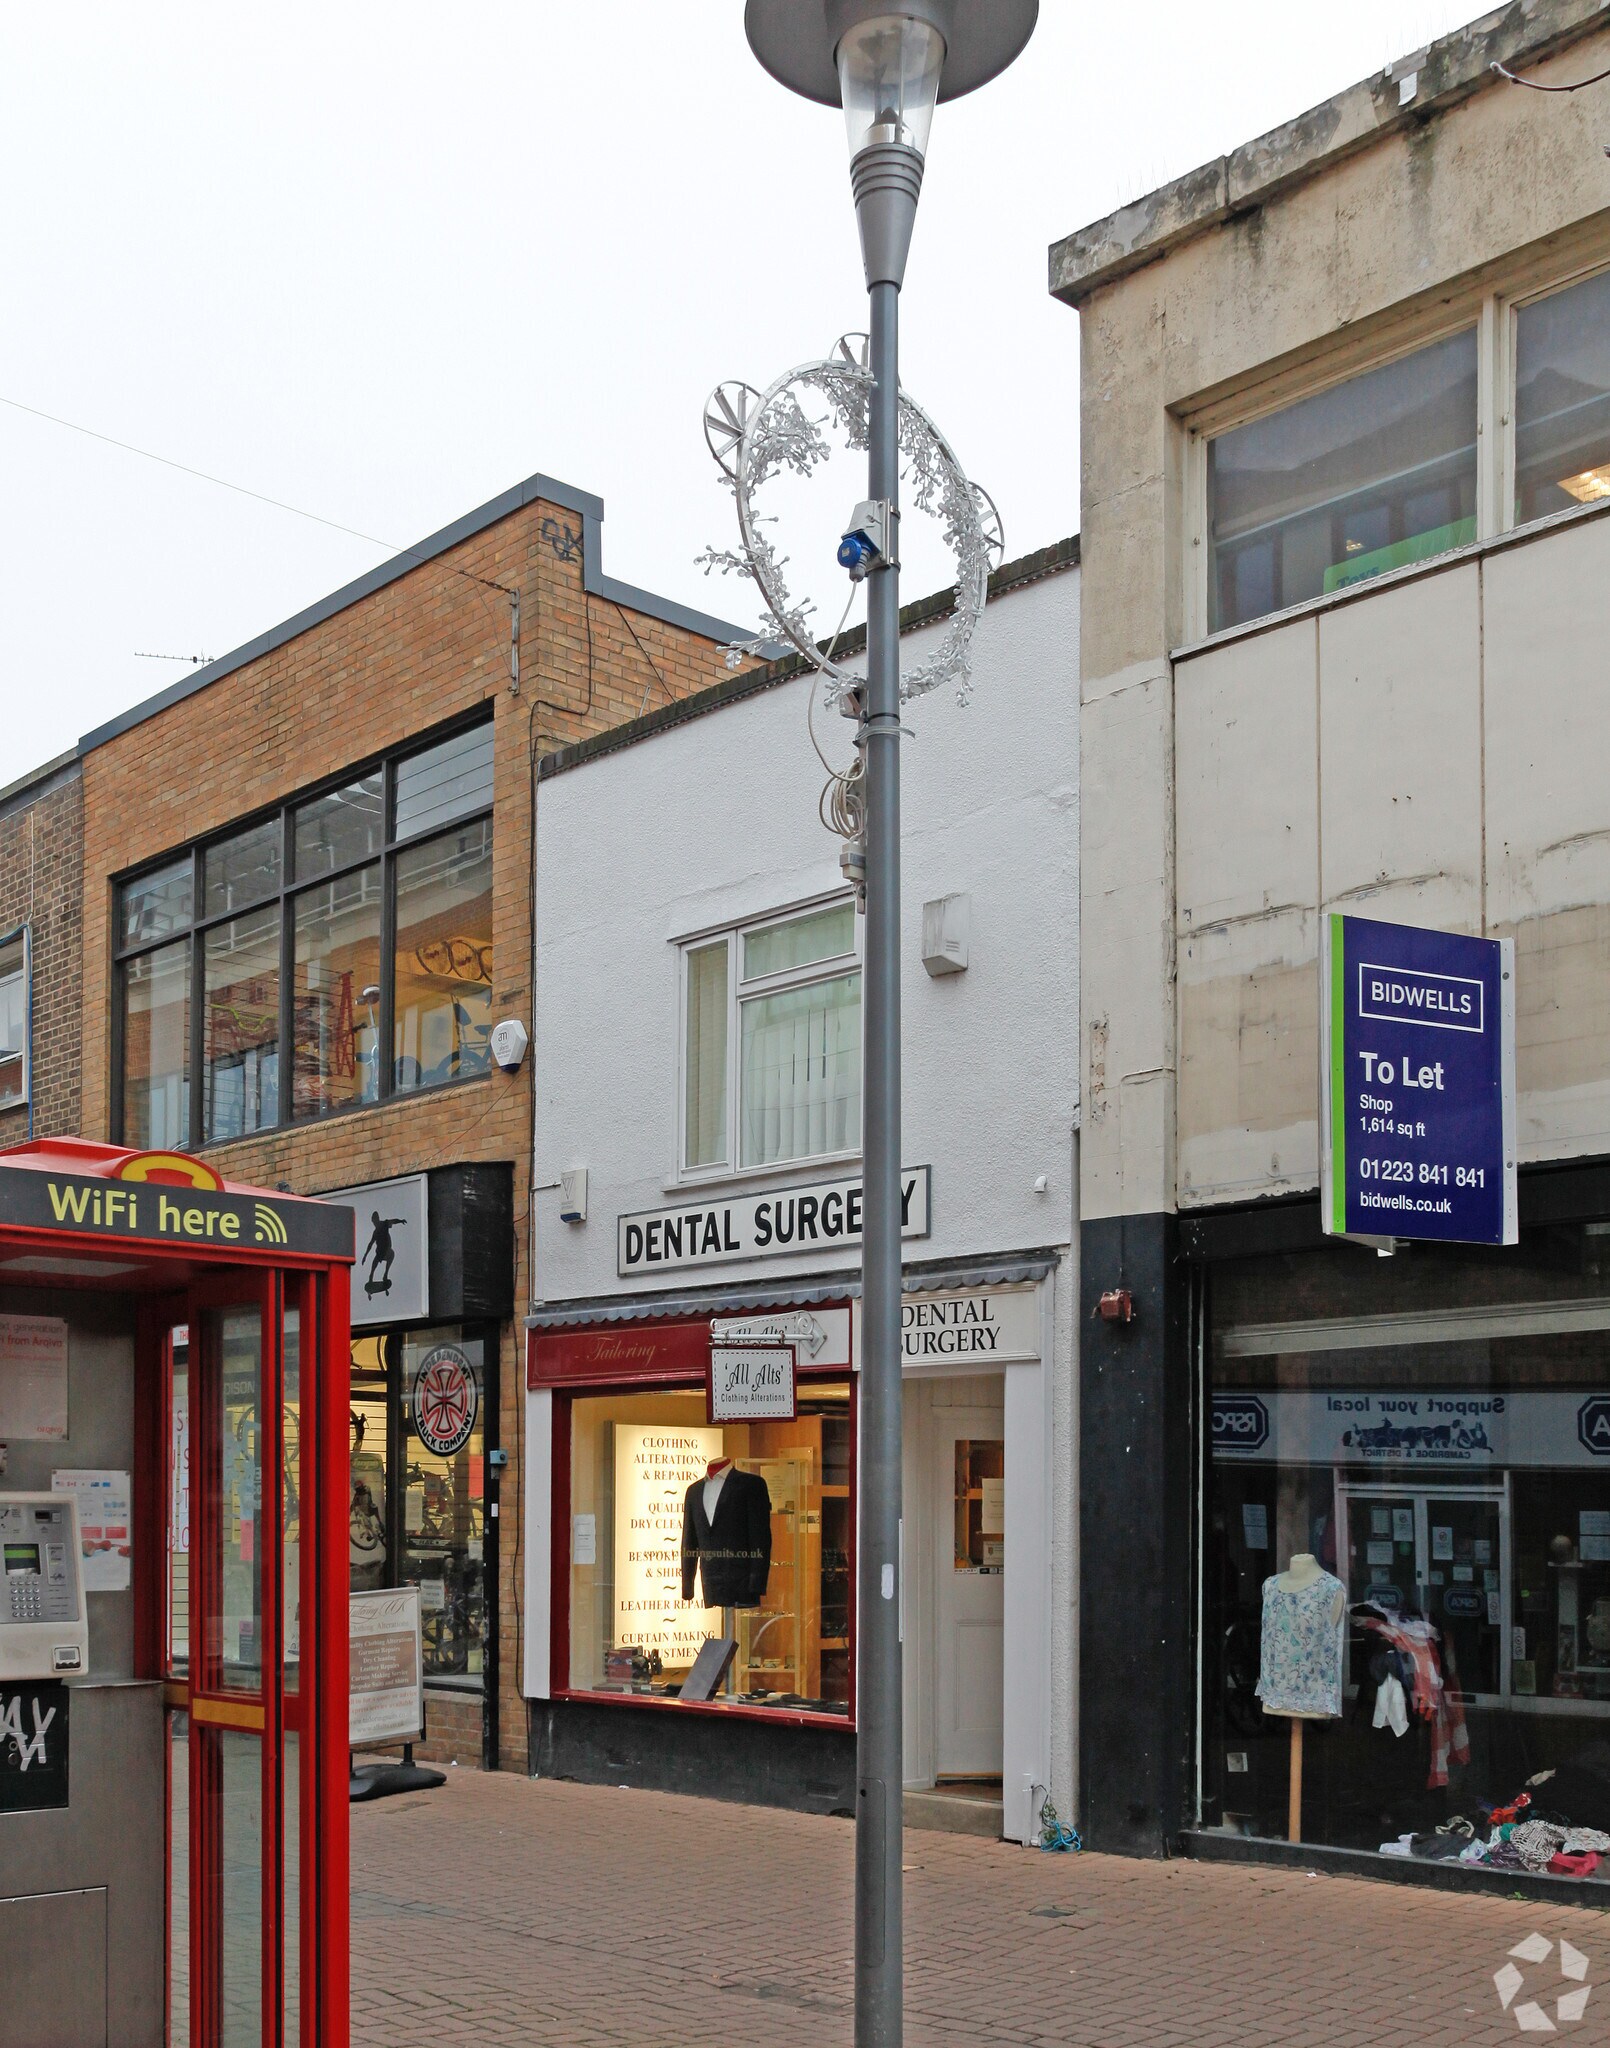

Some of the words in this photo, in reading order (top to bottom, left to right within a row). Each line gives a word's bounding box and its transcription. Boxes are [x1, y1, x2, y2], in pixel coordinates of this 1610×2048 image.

[1371, 981, 1471, 1014] BIDWELLS
[1359, 1052, 1394, 1084] To
[1403, 1056, 1444, 1091] Let
[1360, 1095, 1393, 1113] Shop
[1360, 1117, 1394, 1134] 1,614
[1397, 1123, 1413, 1138] sq
[1416, 1122, 1425, 1137] ft
[1360, 1158, 1413, 1182] 01223
[1419, 1163, 1448, 1185] 841
[1456, 1167, 1485, 1188] 841
[48, 1184, 137, 1228] WiFi
[159, 1195, 240, 1239] here
[1360, 1192, 1451, 1214] bidwells.co.uk
[626, 1209, 740, 1265] DENTAL
[754, 1179, 917, 1247] SURGEY
[901, 1299, 994, 1328] DENTAL
[901, 1326, 1000, 1355] URGERY
[587, 1337, 656, 1367] Tailoring
[420, 1349, 471, 1384] INDEPENDENT
[721, 1393, 748, 1404] Clothing
[751, 1393, 785, 1402] Alterations
[417, 1410, 436, 1447] TRUCK
[439, 1409, 472, 1450] COMPANY
[642, 1438, 698, 1449] CLOTHING
[634, 1454, 707, 1465] ALTERATIONS
[643, 1470, 650, 1480] &
[654, 1470, 699, 1481] REPAIRS
[648, 1503, 685, 1514] QUALIT
[630, 1519, 653, 1529] DRY
[655, 1519, 683, 1529] CLEA
[646, 1568, 653, 1577] &
[656, 1568, 683, 1577] SHIR
[621, 1600, 672, 1611] LEATHER
[674, 1600, 704, 1609] REPAI
[622, 1632, 669, 1644] CURTAIN
[673, 1631, 715, 1642] MAKING
